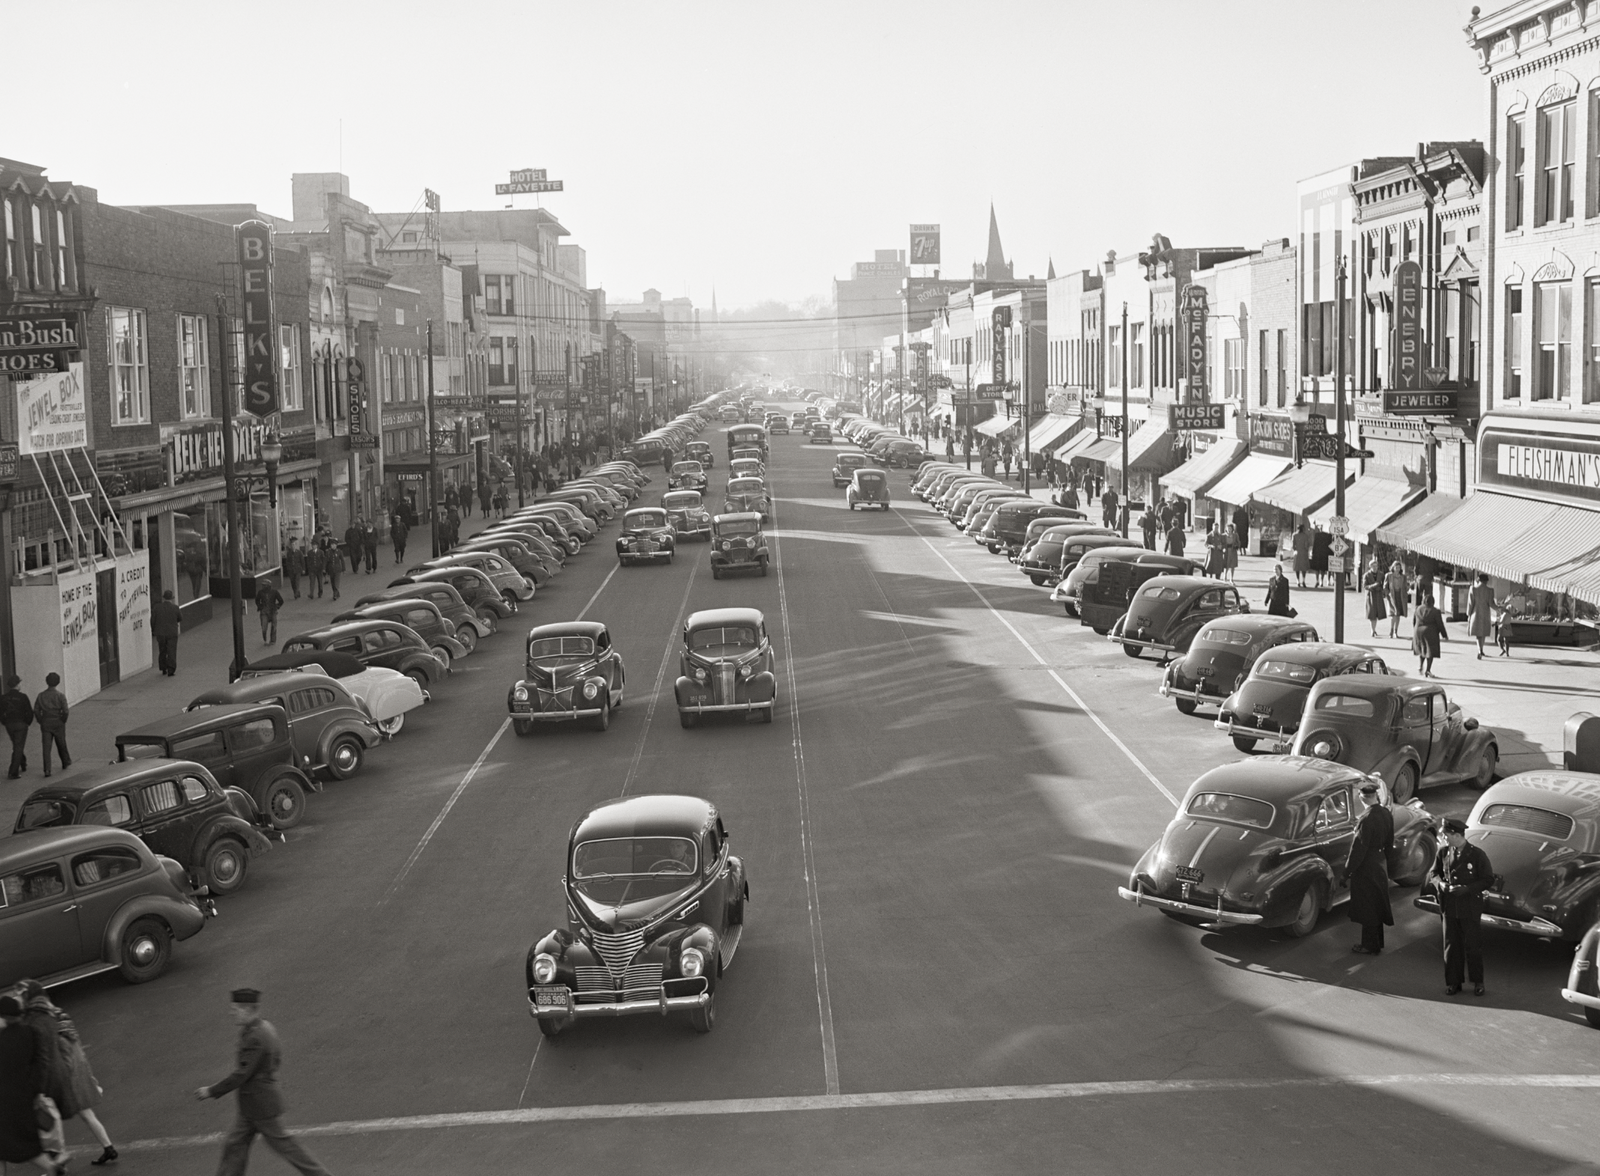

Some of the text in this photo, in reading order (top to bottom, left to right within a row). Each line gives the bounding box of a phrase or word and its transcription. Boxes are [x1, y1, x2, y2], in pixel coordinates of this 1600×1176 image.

[511, 171, 546, 182] HOTEL
[509, 181, 561, 193] FAYETTE
[916, 287, 943, 303] ROYAL
[243, 237, 271, 405] BELK'S
[1402, 271, 1416, 387] HENEBRY
[995, 313, 1003, 381] RAYLASS
[28, 368, 80, 431] JEWEL BOX
[1392, 395, 1449, 406] JEWELER
[350, 384, 360, 434] SHOES
[487, 407, 525, 416] FLORSHEM
[1174, 407, 1221, 418] MUSIC
[1177, 419, 1219, 427] STORE
[1274, 422, 1291, 440] SHOES
[1508, 446, 1600, 488] FLEISHMAN'S
[398, 473, 423, 481] EFIRD'S
[121, 566, 145, 584] A CREDIT
[62, 582, 93, 604] HOME OF THE
[62, 611, 83, 645] JEWEL
[82, 600, 97, 623] BOX
